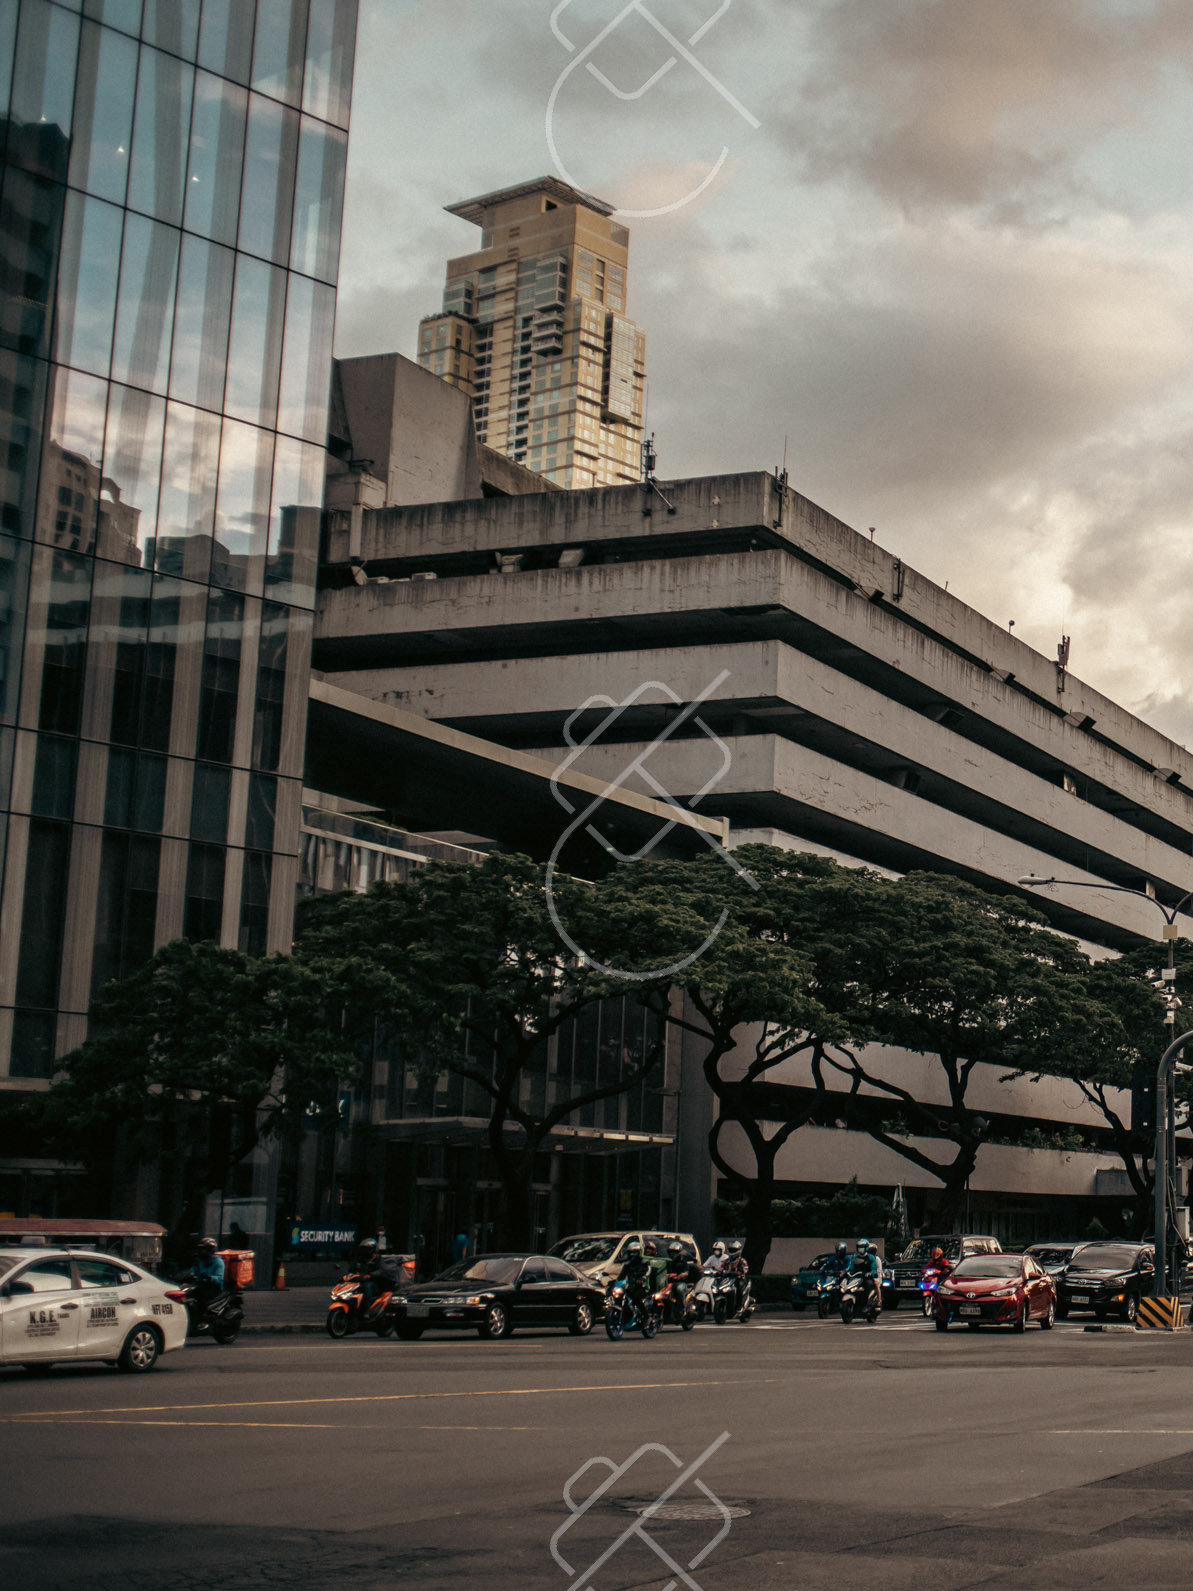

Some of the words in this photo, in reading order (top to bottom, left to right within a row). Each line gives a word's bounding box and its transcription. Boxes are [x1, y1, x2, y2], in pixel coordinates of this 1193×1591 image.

[300, 1230, 334, 1242] SECURITY
[334, 1231, 355, 1242] BANK
[90, 1306, 116, 1319] AIRCON
